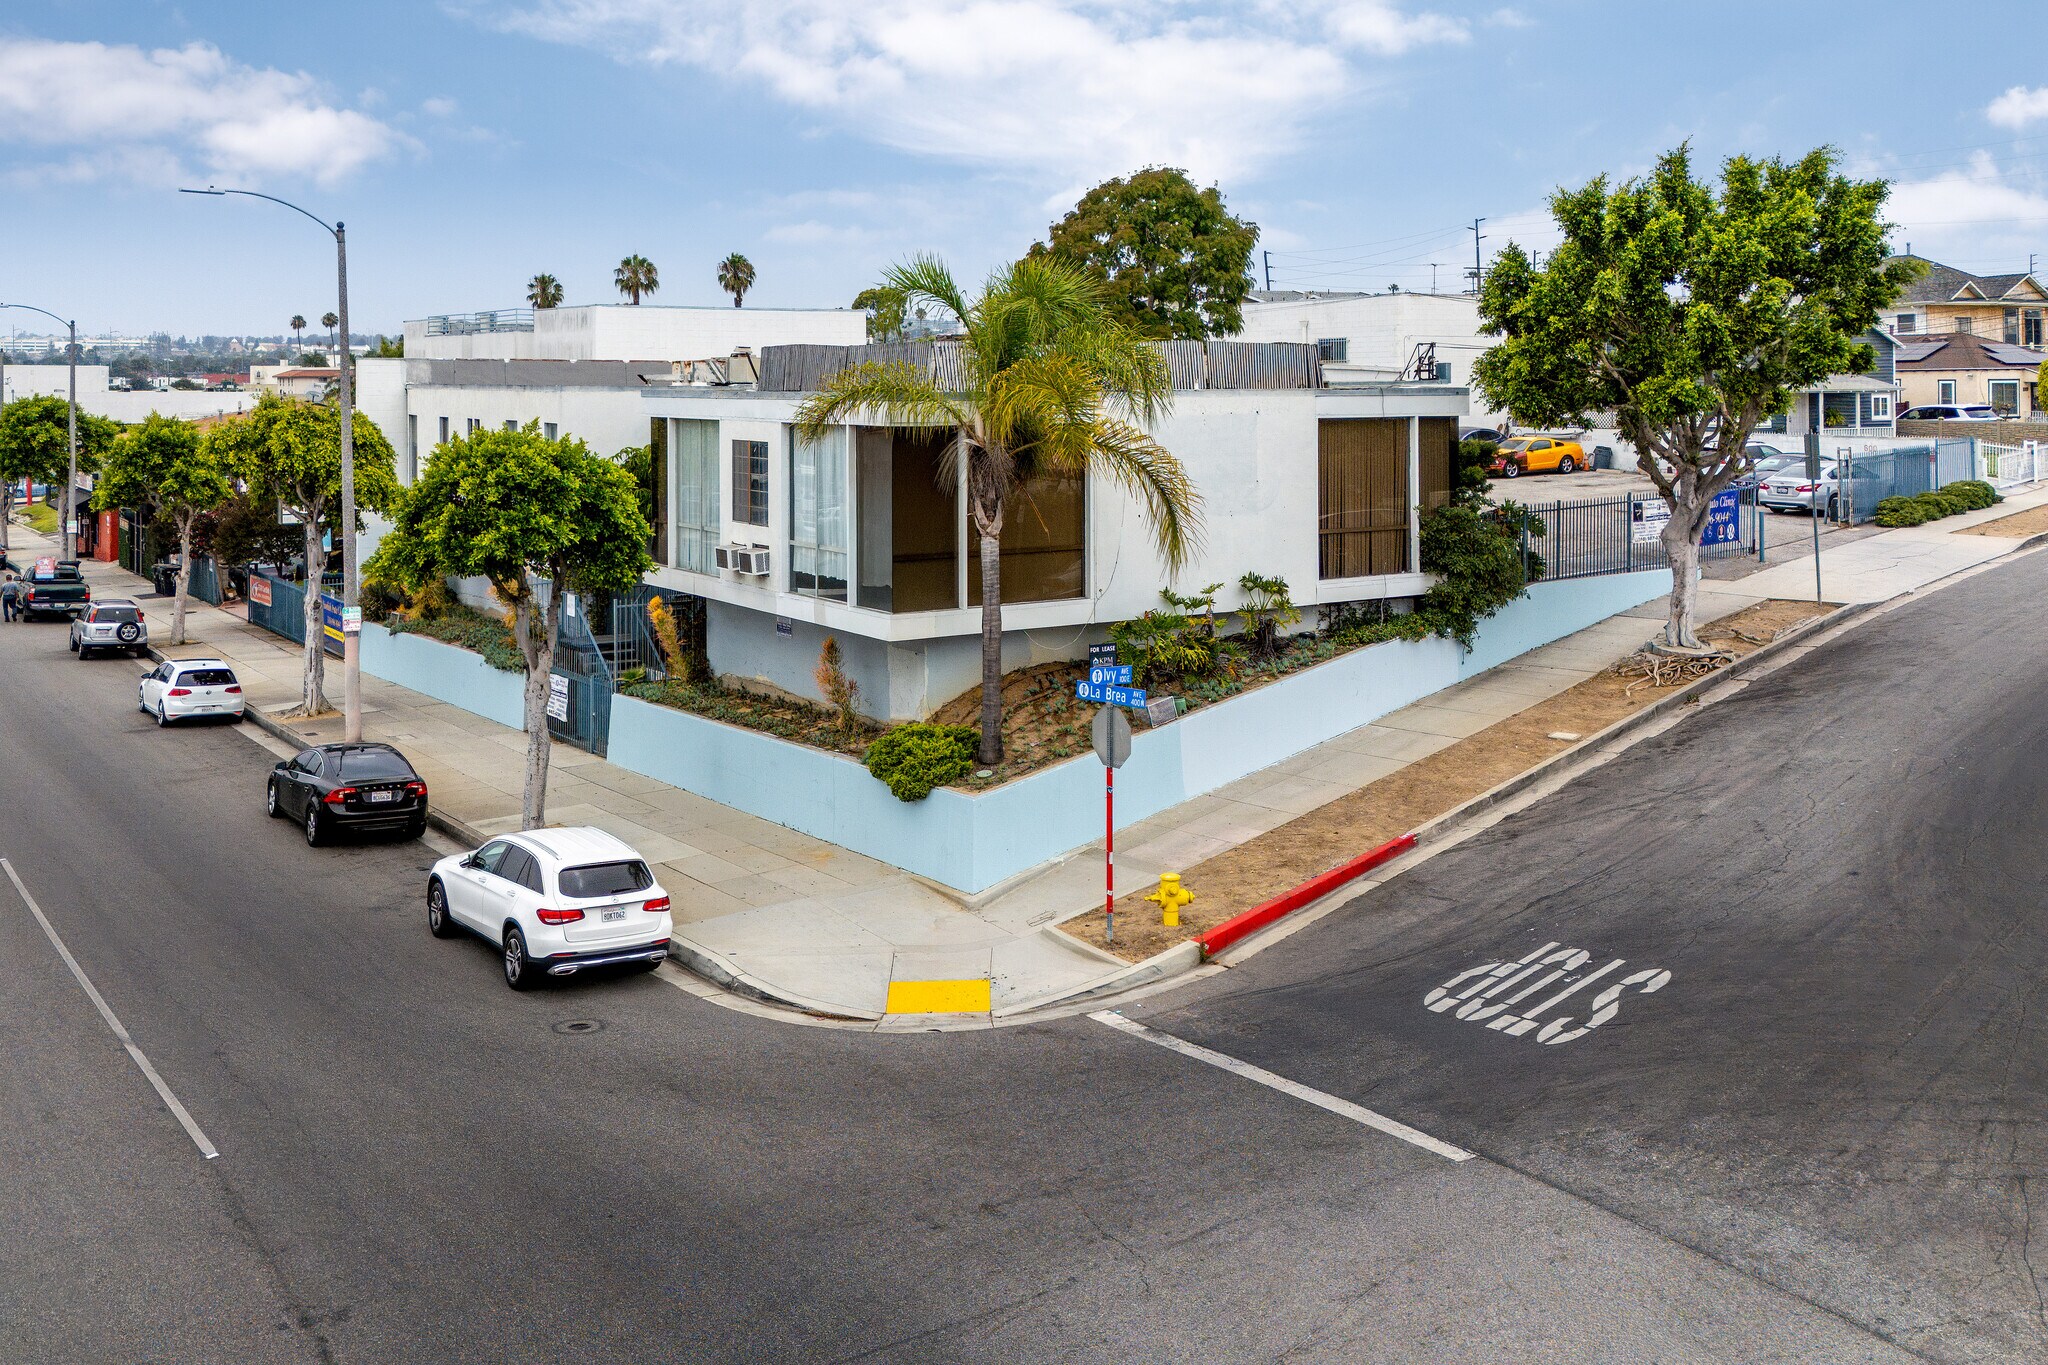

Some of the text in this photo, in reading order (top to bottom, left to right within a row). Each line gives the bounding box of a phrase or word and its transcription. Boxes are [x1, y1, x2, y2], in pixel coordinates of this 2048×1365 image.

[1104, 668, 1117, 684] Ivy
[1090, 686, 1100, 698] La
[1106, 687, 1126, 702] Brea
[1424, 941, 1672, 1045] STOP
